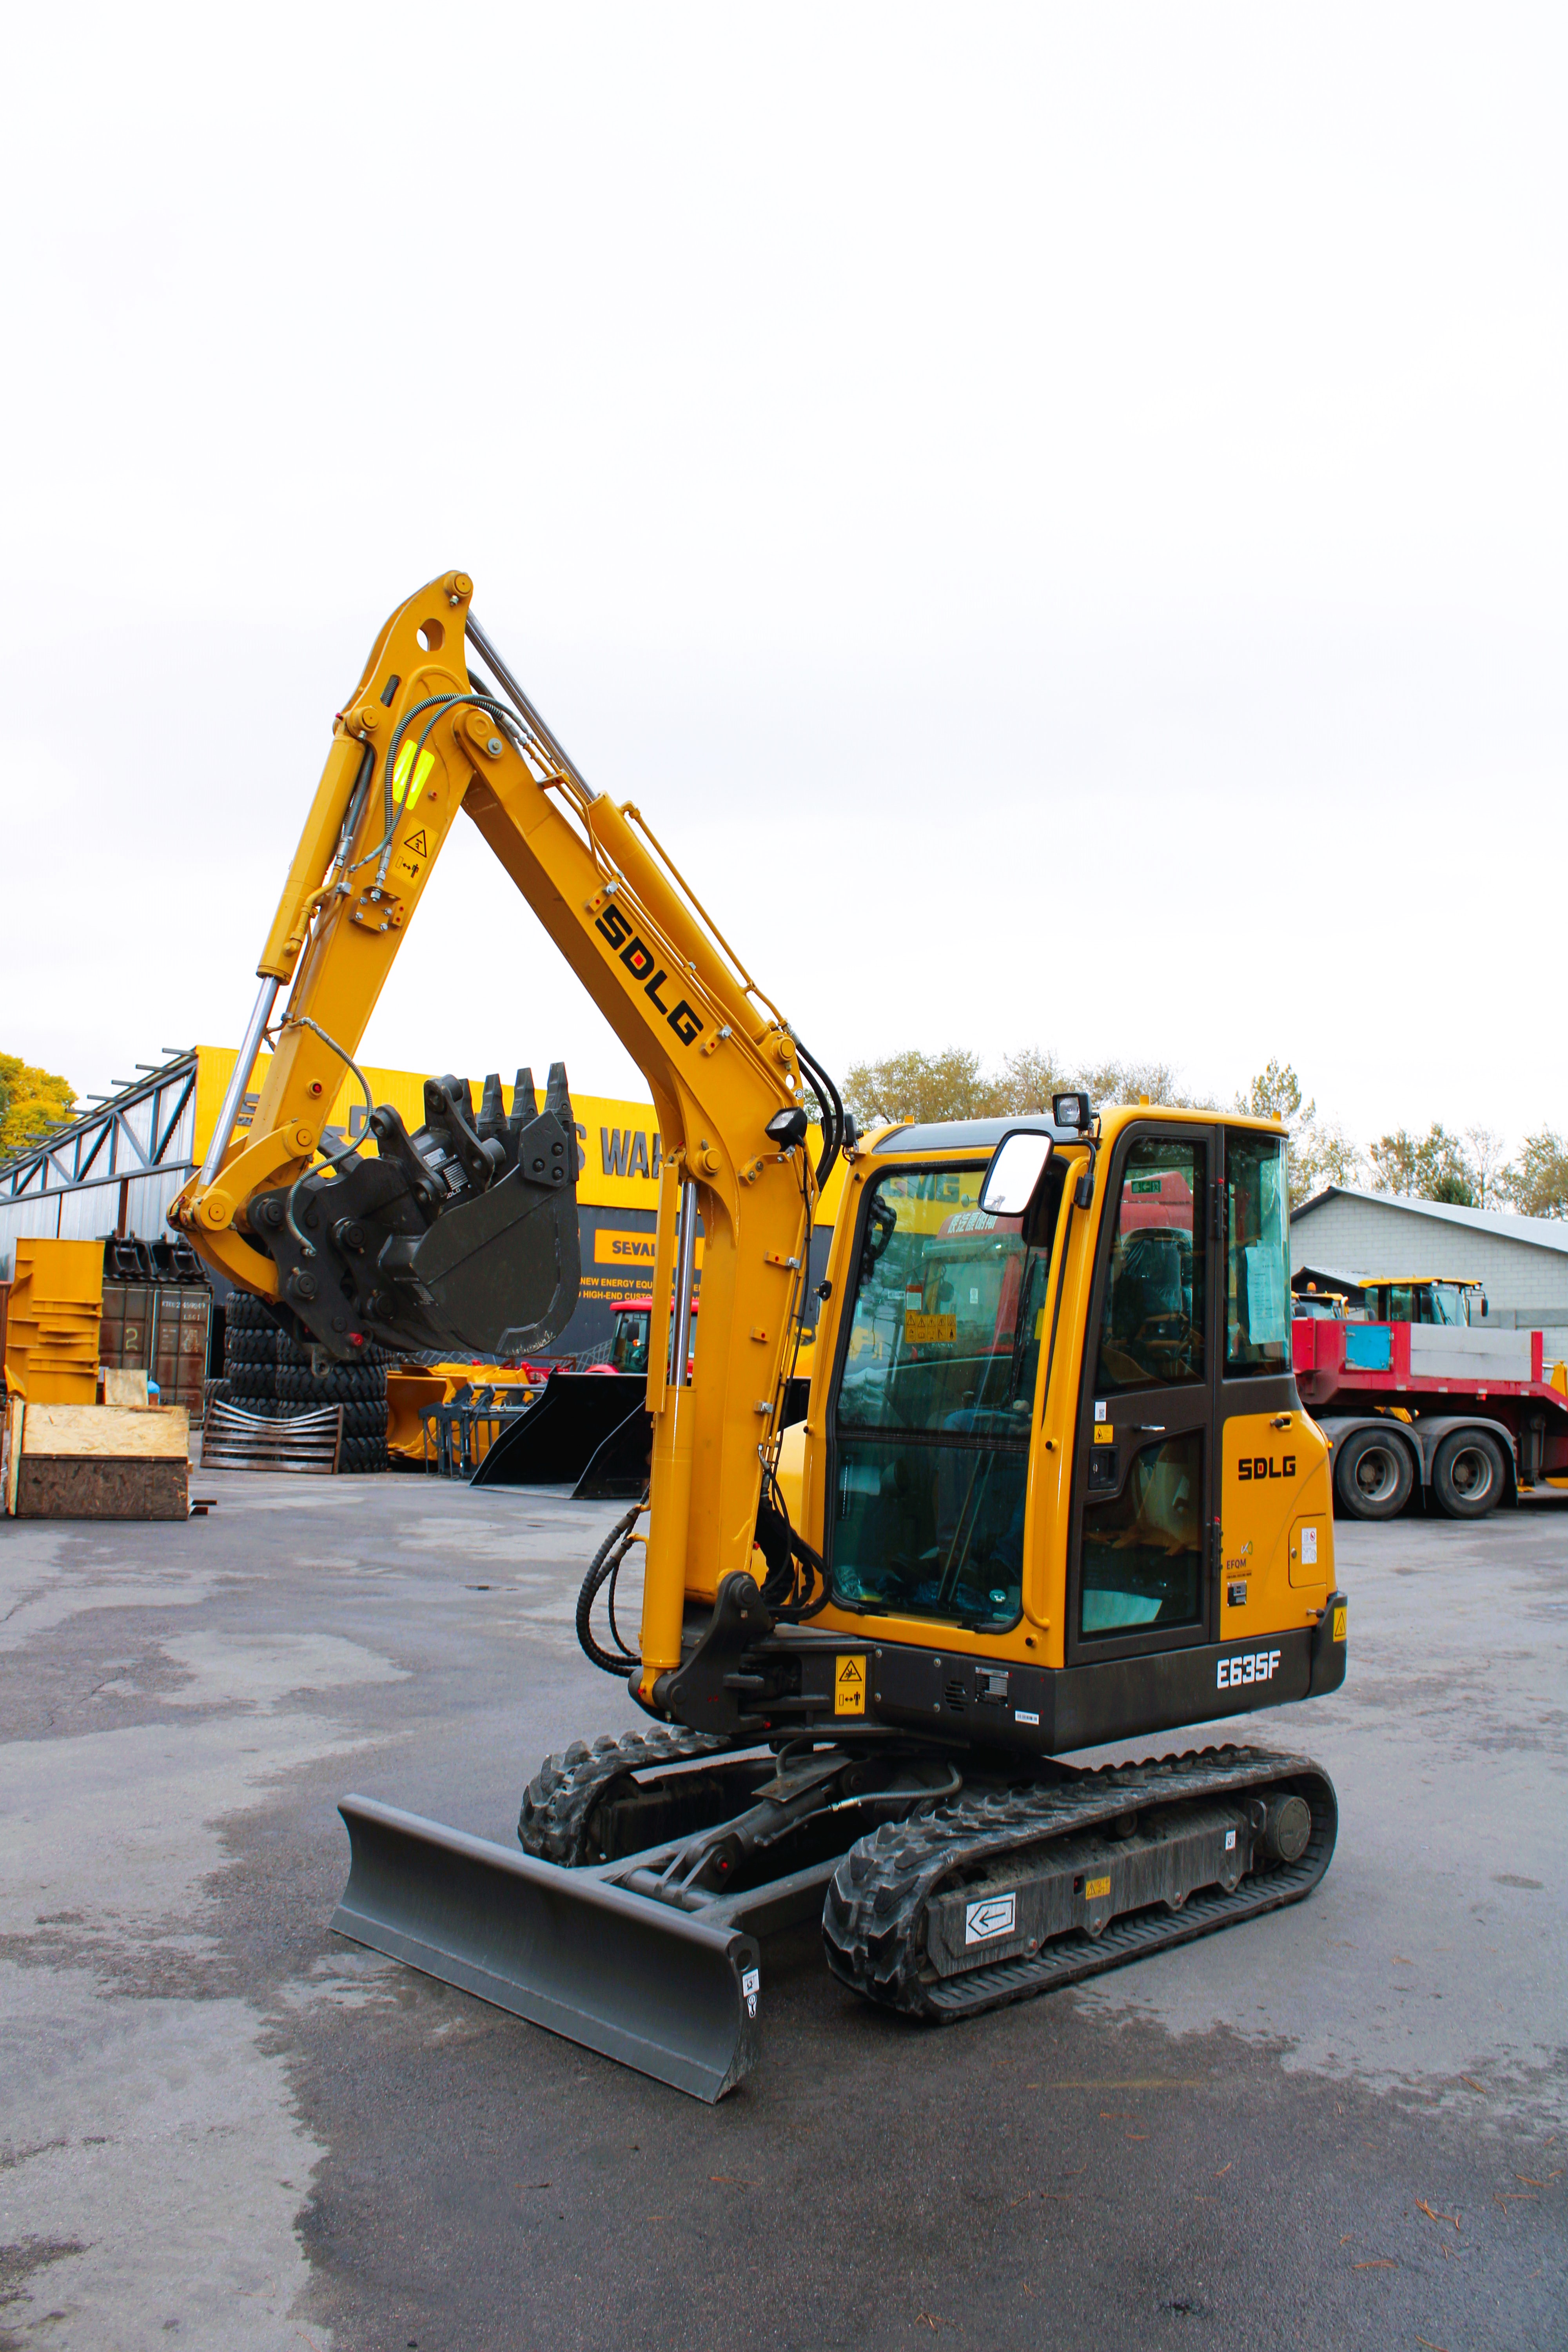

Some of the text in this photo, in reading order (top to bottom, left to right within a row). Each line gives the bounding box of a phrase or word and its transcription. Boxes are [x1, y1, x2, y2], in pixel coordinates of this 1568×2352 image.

[595, 904, 704, 1047] SDLG
[876, 1173, 960, 1203] CMG
[581, 1277, 599, 1285] NEW
[601, 1278, 634, 1288] ENERGY
[583, 1290, 622, 1300] HIGH-END
[125, 1327, 138, 1350] 2
[1238, 1455, 1296, 1481] SDLG
[1227, 1558, 1246, 1570] EFQM
[1217, 1650, 1281, 1689] E635F
